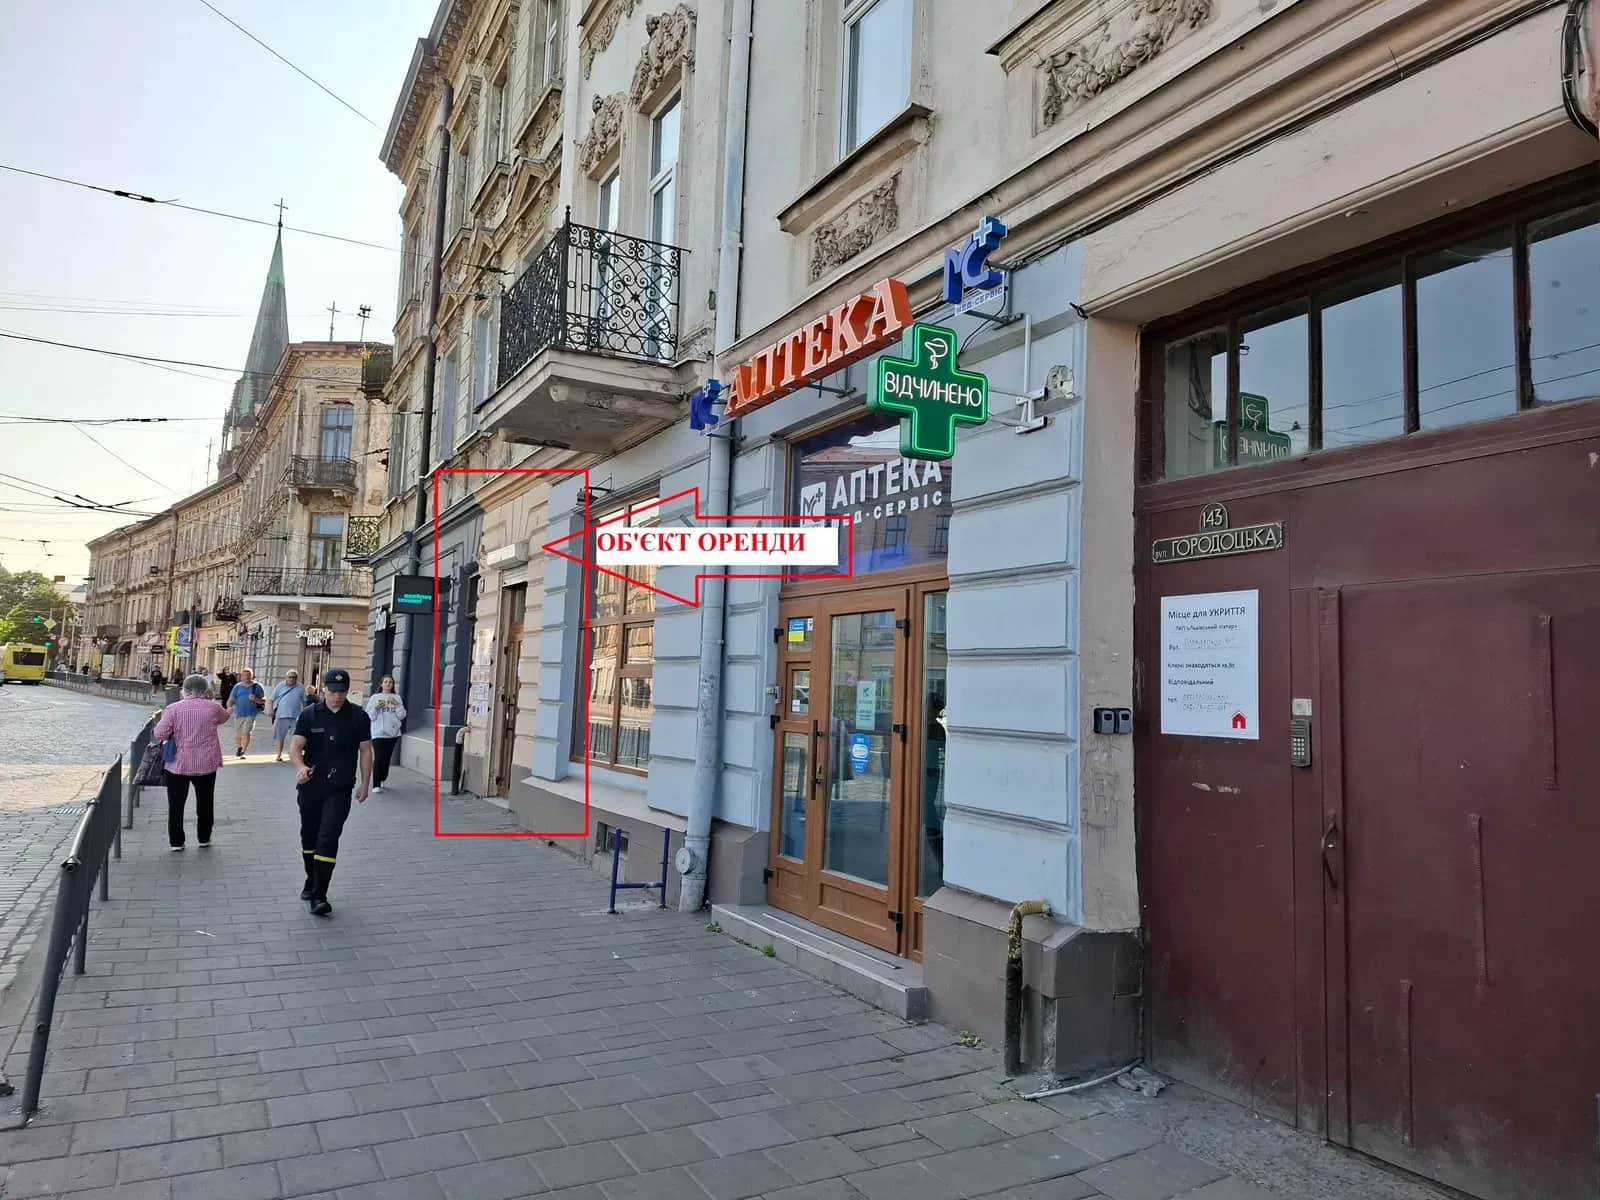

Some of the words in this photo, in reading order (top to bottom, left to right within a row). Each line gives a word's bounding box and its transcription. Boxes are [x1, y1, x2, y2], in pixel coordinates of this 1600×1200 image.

[723, 277, 905, 416] АПТЕКА
[884, 370, 983, 408] ВІДЧИНЕНО
[832, 457, 943, 509] АПТЕКА
[1202, 508, 1223, 528] 143
[1171, 527, 1278, 557] ГОРОДОЦЬКА
[1168, 610, 1191, 620] Місце
[1192, 610, 1207, 619] для
[1209, 606, 1246, 617] УКРИТТЯ
